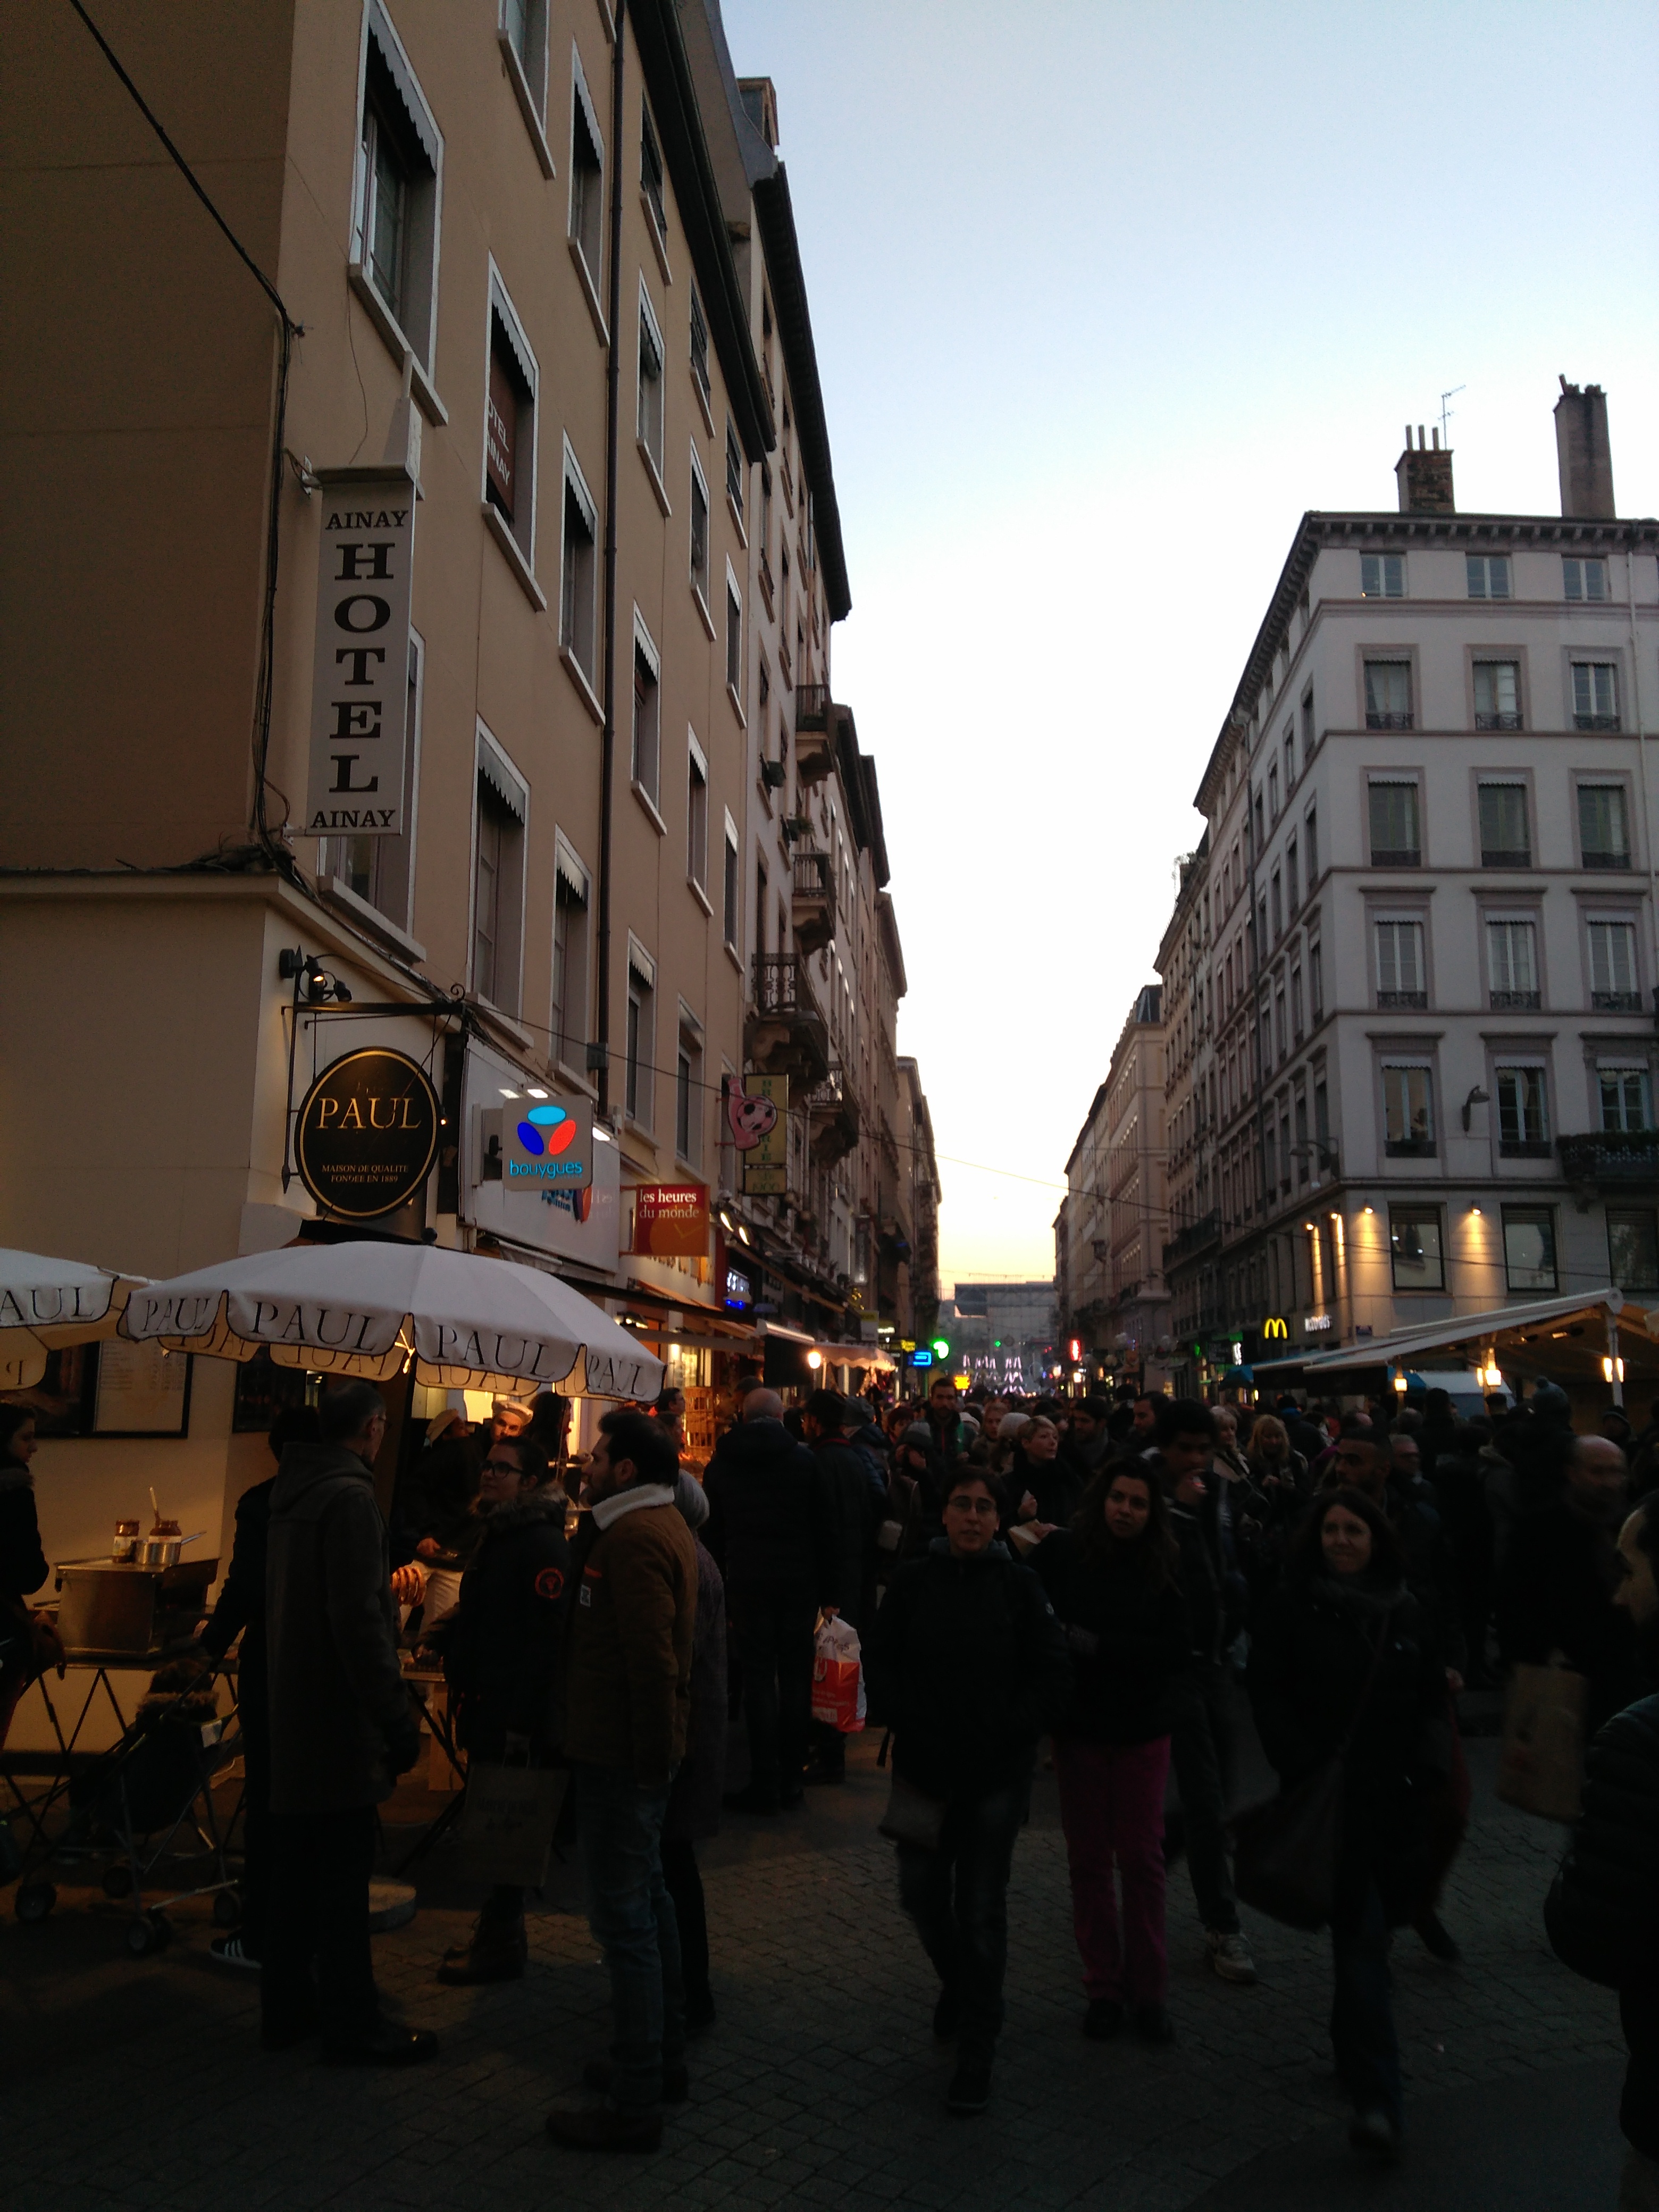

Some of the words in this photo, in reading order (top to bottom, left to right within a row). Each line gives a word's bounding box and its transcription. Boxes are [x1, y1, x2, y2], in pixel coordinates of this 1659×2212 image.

[325, 509, 409, 530] AINAY
[329, 542, 396, 792] HOTEL
[311, 809, 396, 828] AINAY
[315, 1097, 422, 1129] PAUL
[322, 1164, 356, 1173] MAISON
[357, 1164, 369, 1173] DE
[366, 1174, 379, 1183] EN
[381, 1174, 399, 1183] 1889
[509, 1159, 583, 1179] bouygues
[640, 1188, 655, 1203] les
[658, 1188, 697, 1203] heures
[639, 1204, 655, 1219] du
[658, 1203, 699, 1219] monde
[141, 1297, 210, 1331] PAUL
[248, 1301, 376, 1351] PAUL
[433, 1323, 555, 1378] PAUL
[587, 1356, 647, 1397] PAUL
